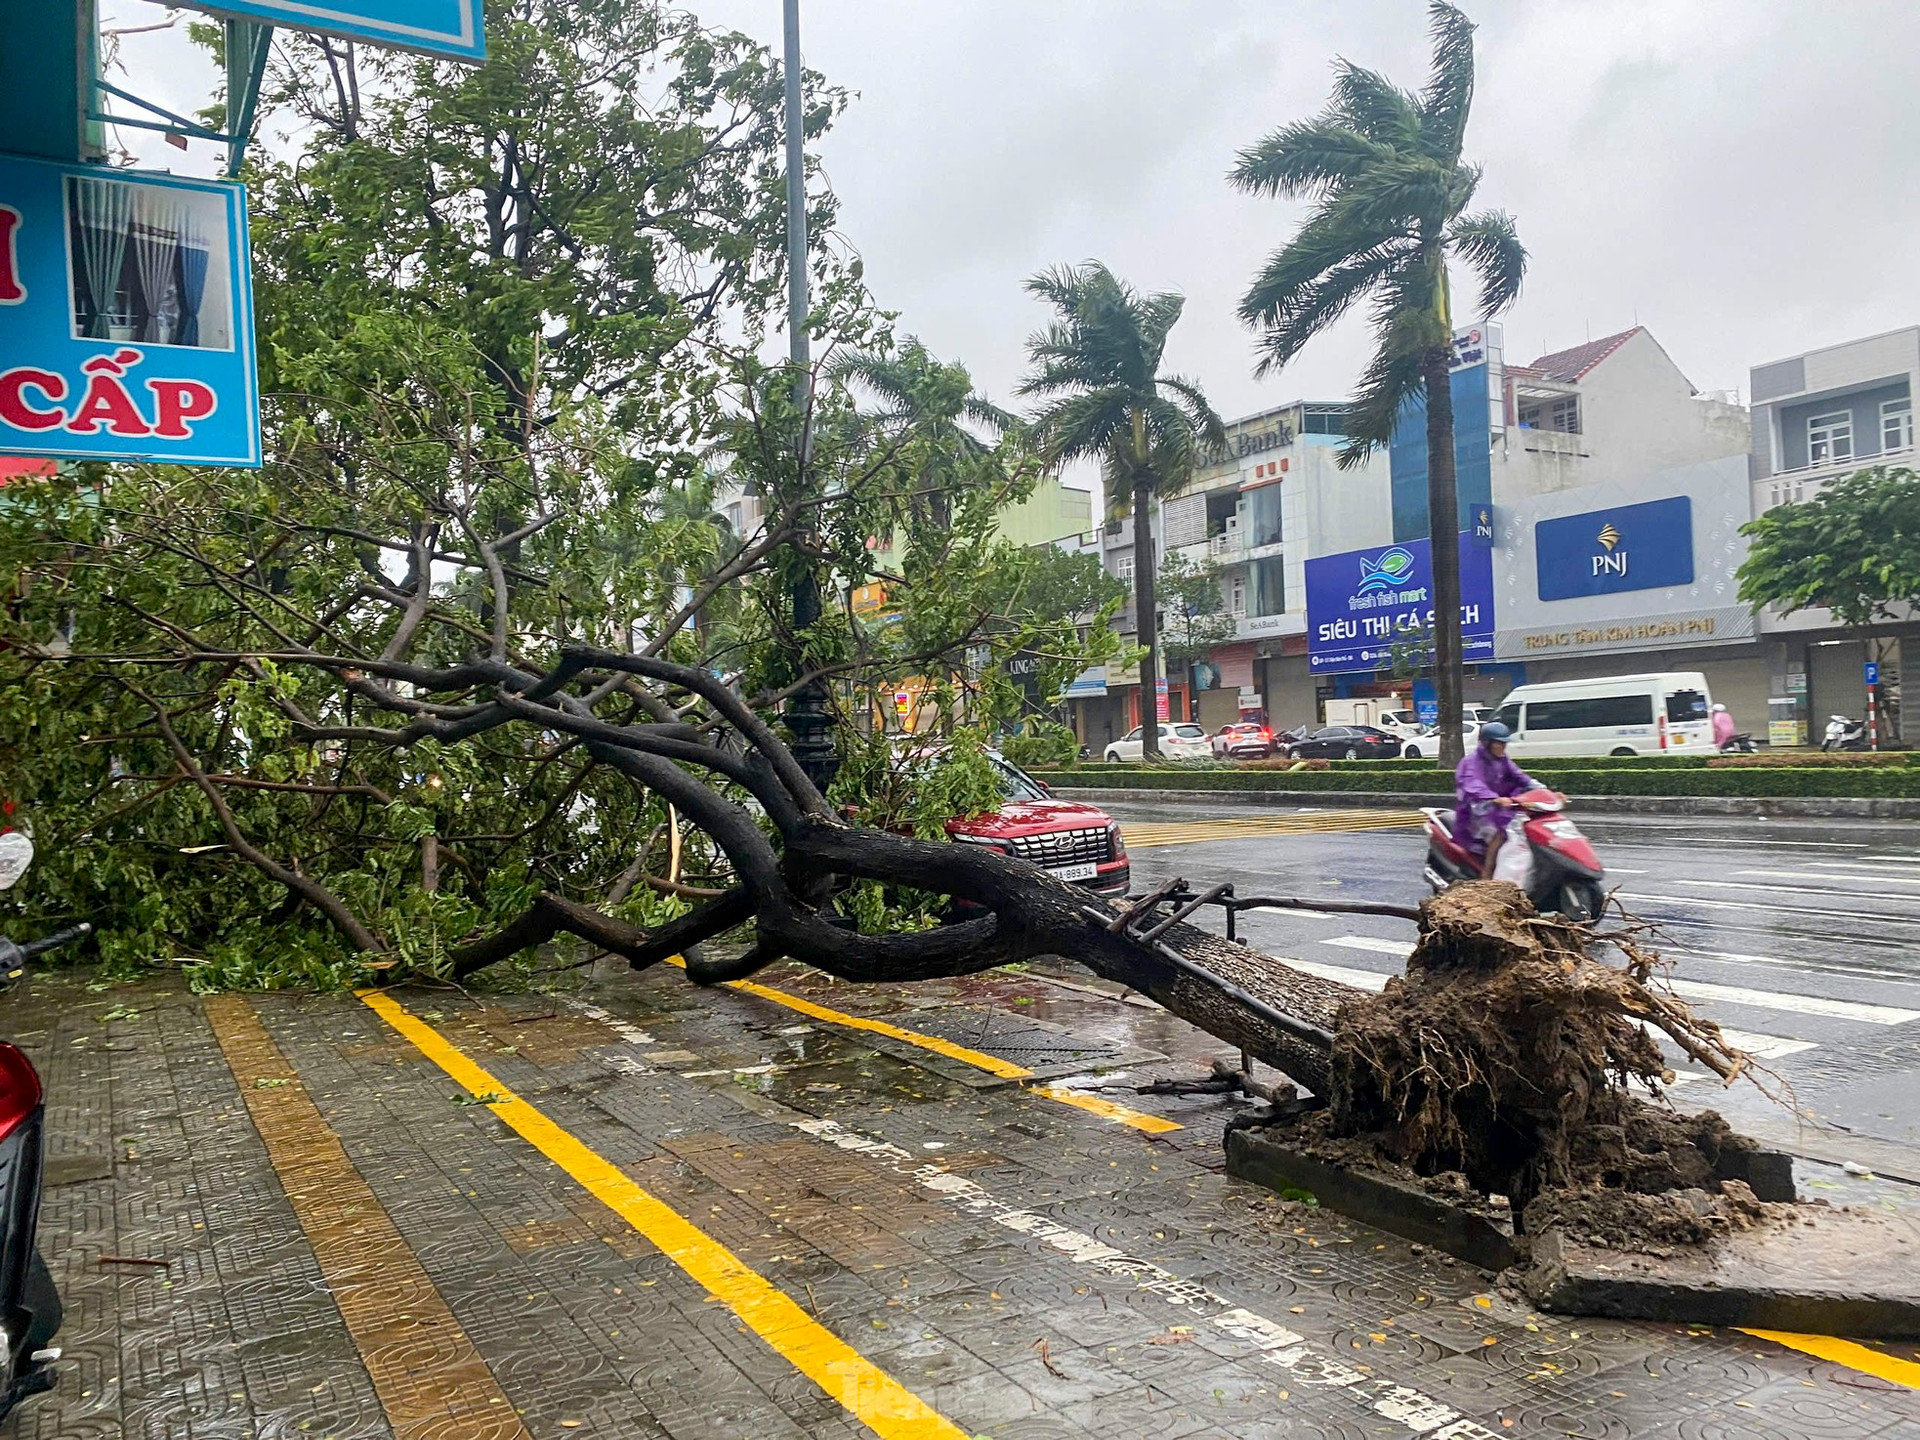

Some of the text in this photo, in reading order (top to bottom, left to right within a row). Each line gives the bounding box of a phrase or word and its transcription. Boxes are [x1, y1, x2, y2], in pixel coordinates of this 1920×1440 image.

[0, 348, 217, 438] CẤP
[1476, 525, 1492, 539] PNJ
[1592, 552, 1627, 577] PNJ
[1348, 587, 1427, 611] fresh fish mart
[1318, 618, 1357, 642] SIÊU
[1362, 615, 1391, 637] THỊ
[1396, 608, 1421, 632] CÁ
[1867, 667, 1876, 680] P
